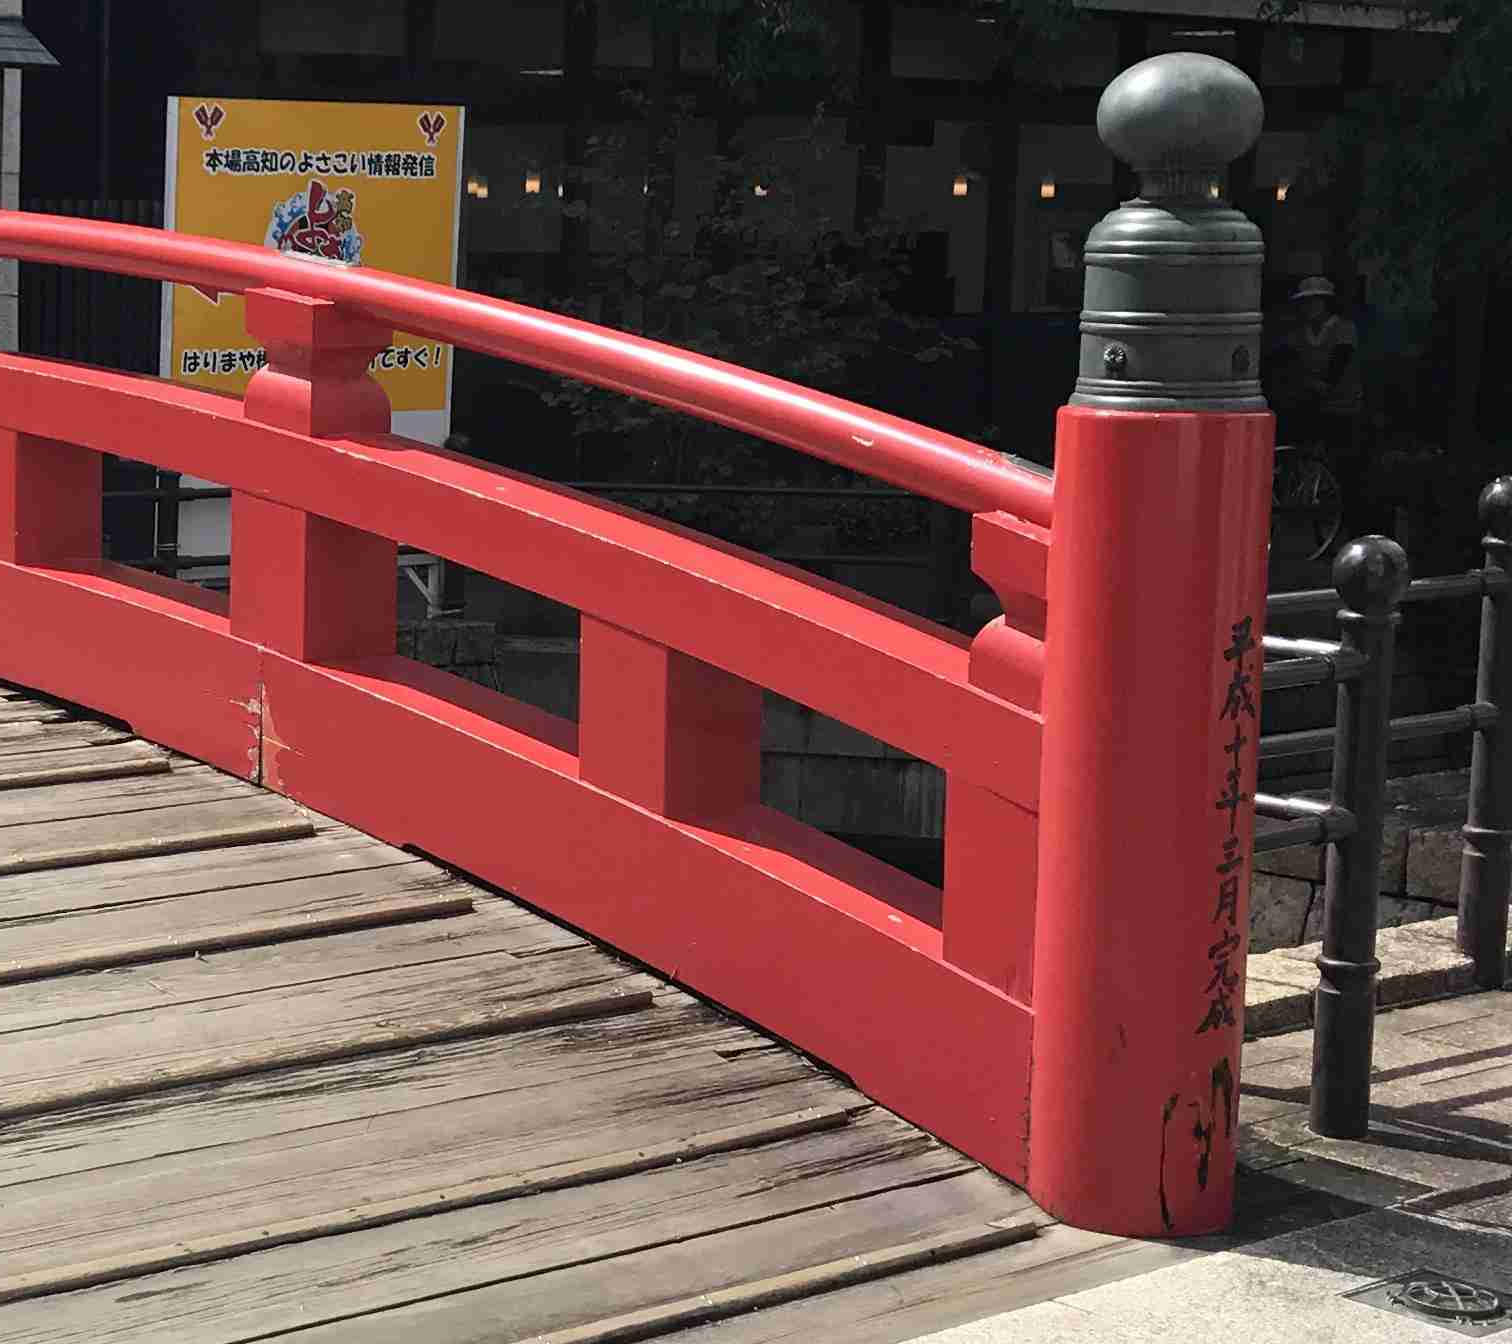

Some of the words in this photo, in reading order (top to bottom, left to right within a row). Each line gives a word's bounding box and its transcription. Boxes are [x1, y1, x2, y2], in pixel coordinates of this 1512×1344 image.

[204, 148, 437, 177] 本場高知のよさこい情報発信
